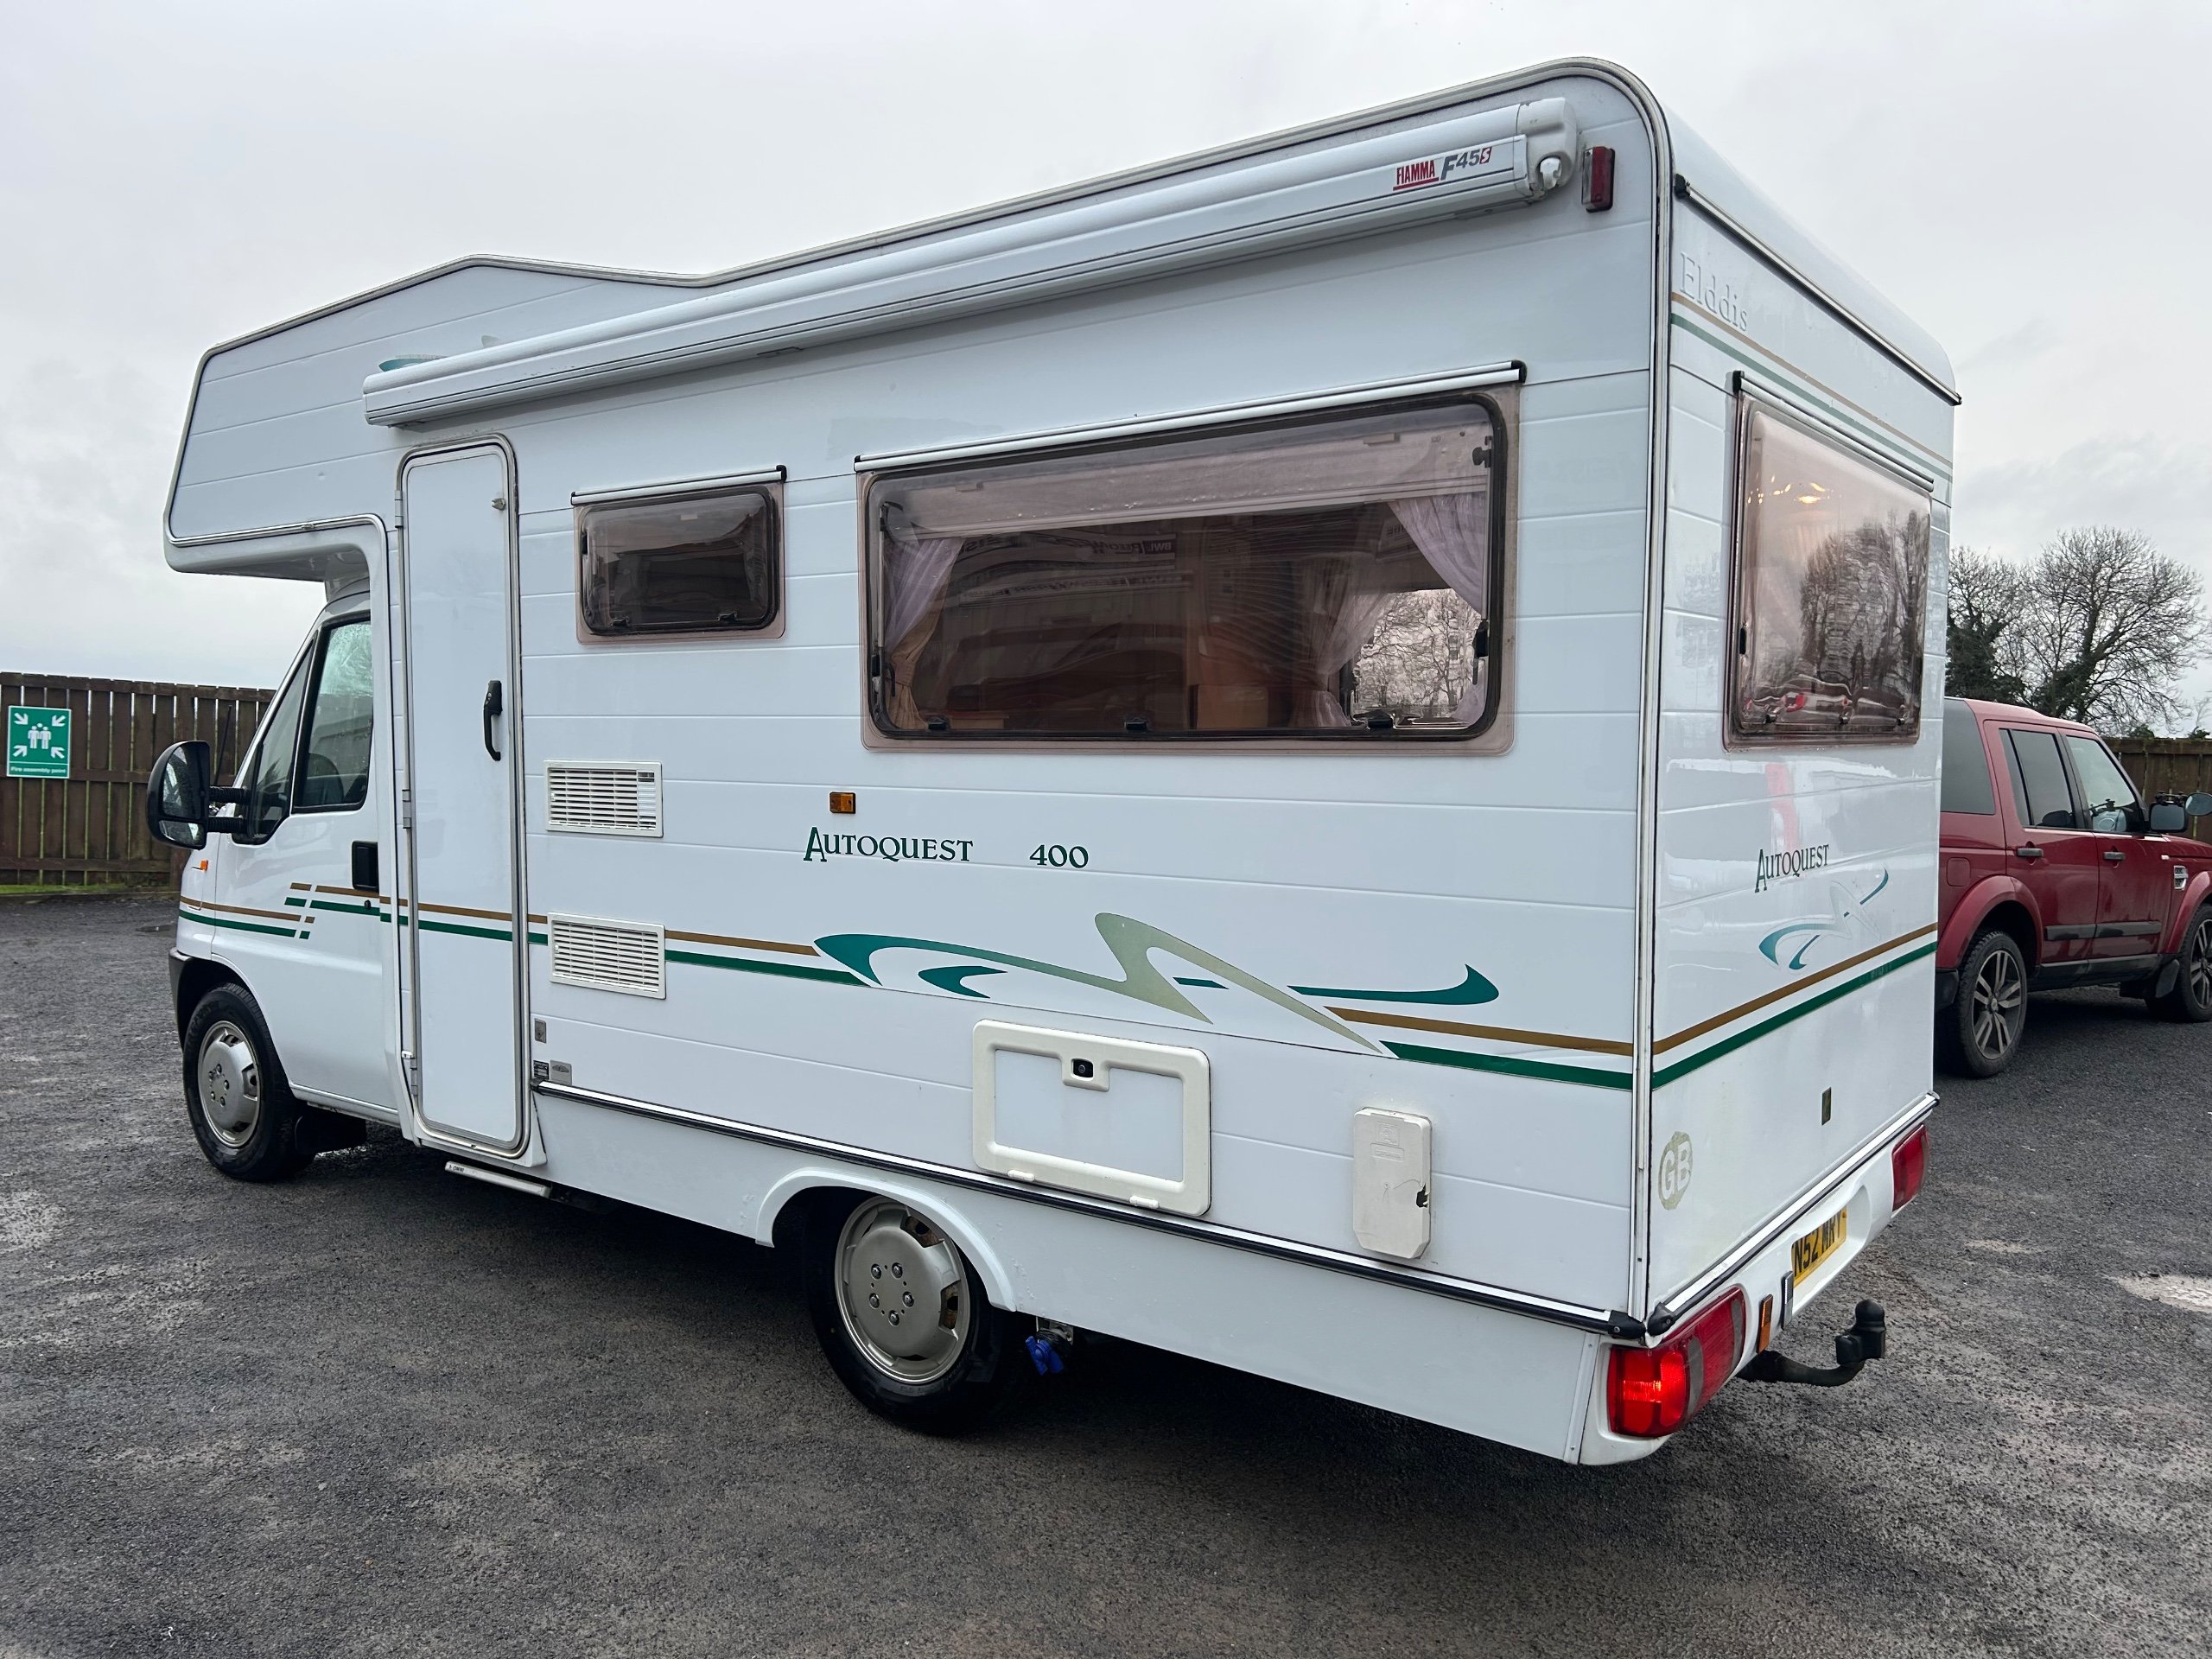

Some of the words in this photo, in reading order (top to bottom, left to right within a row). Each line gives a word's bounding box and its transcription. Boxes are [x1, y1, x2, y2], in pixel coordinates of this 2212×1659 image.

[1396, 160, 1436, 185] FIAMMA
[1679, 251, 1748, 332] Elddis
[803, 826, 974, 862] AUTOQUEST
[1029, 844, 1090, 869] 400
[1754, 843, 1830, 893] AUTOQUEST
[1661, 1141, 1692, 1201] GB
[1791, 1227, 1819, 1277] N52
